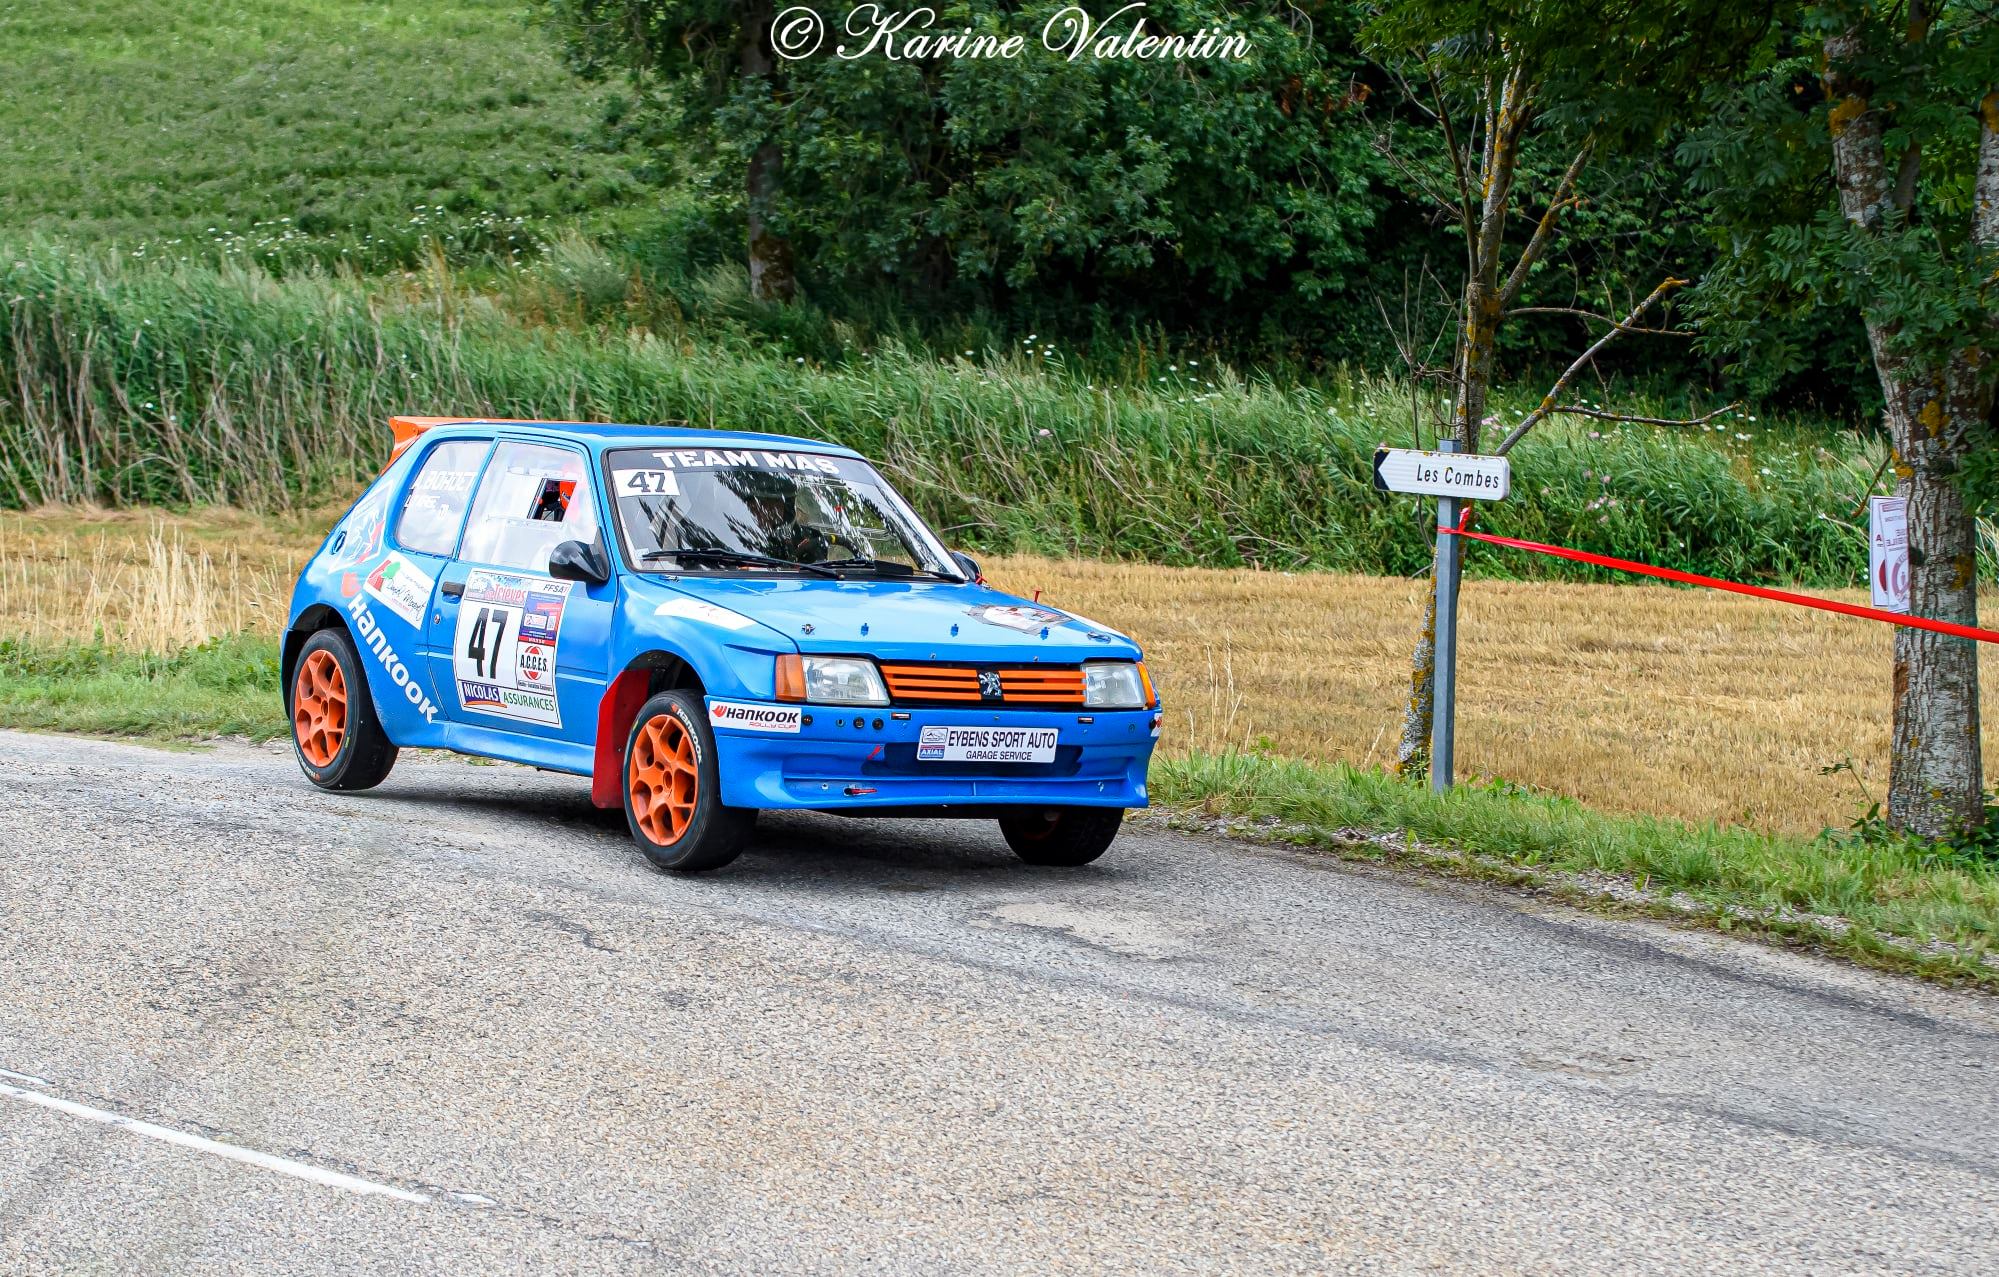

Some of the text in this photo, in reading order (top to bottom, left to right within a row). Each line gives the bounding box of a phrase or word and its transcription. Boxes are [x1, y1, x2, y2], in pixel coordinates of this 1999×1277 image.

[652, 451, 840, 475] TEAM MAS
[627, 471, 666, 493] 47
[1416, 463, 1499, 489] Les Combes
[543, 583, 564, 593] FFSA
[468, 607, 509, 679] 47
[520, 654, 548, 672] A.C.C.E.S.
[463, 682, 499, 701] NICOLAS
[503, 691, 555, 712] ASSURANCES
[948, 730, 1056, 749] EYBENS SPORT AUTO
[966, 750, 1032, 761] GARAGE SERVICE
